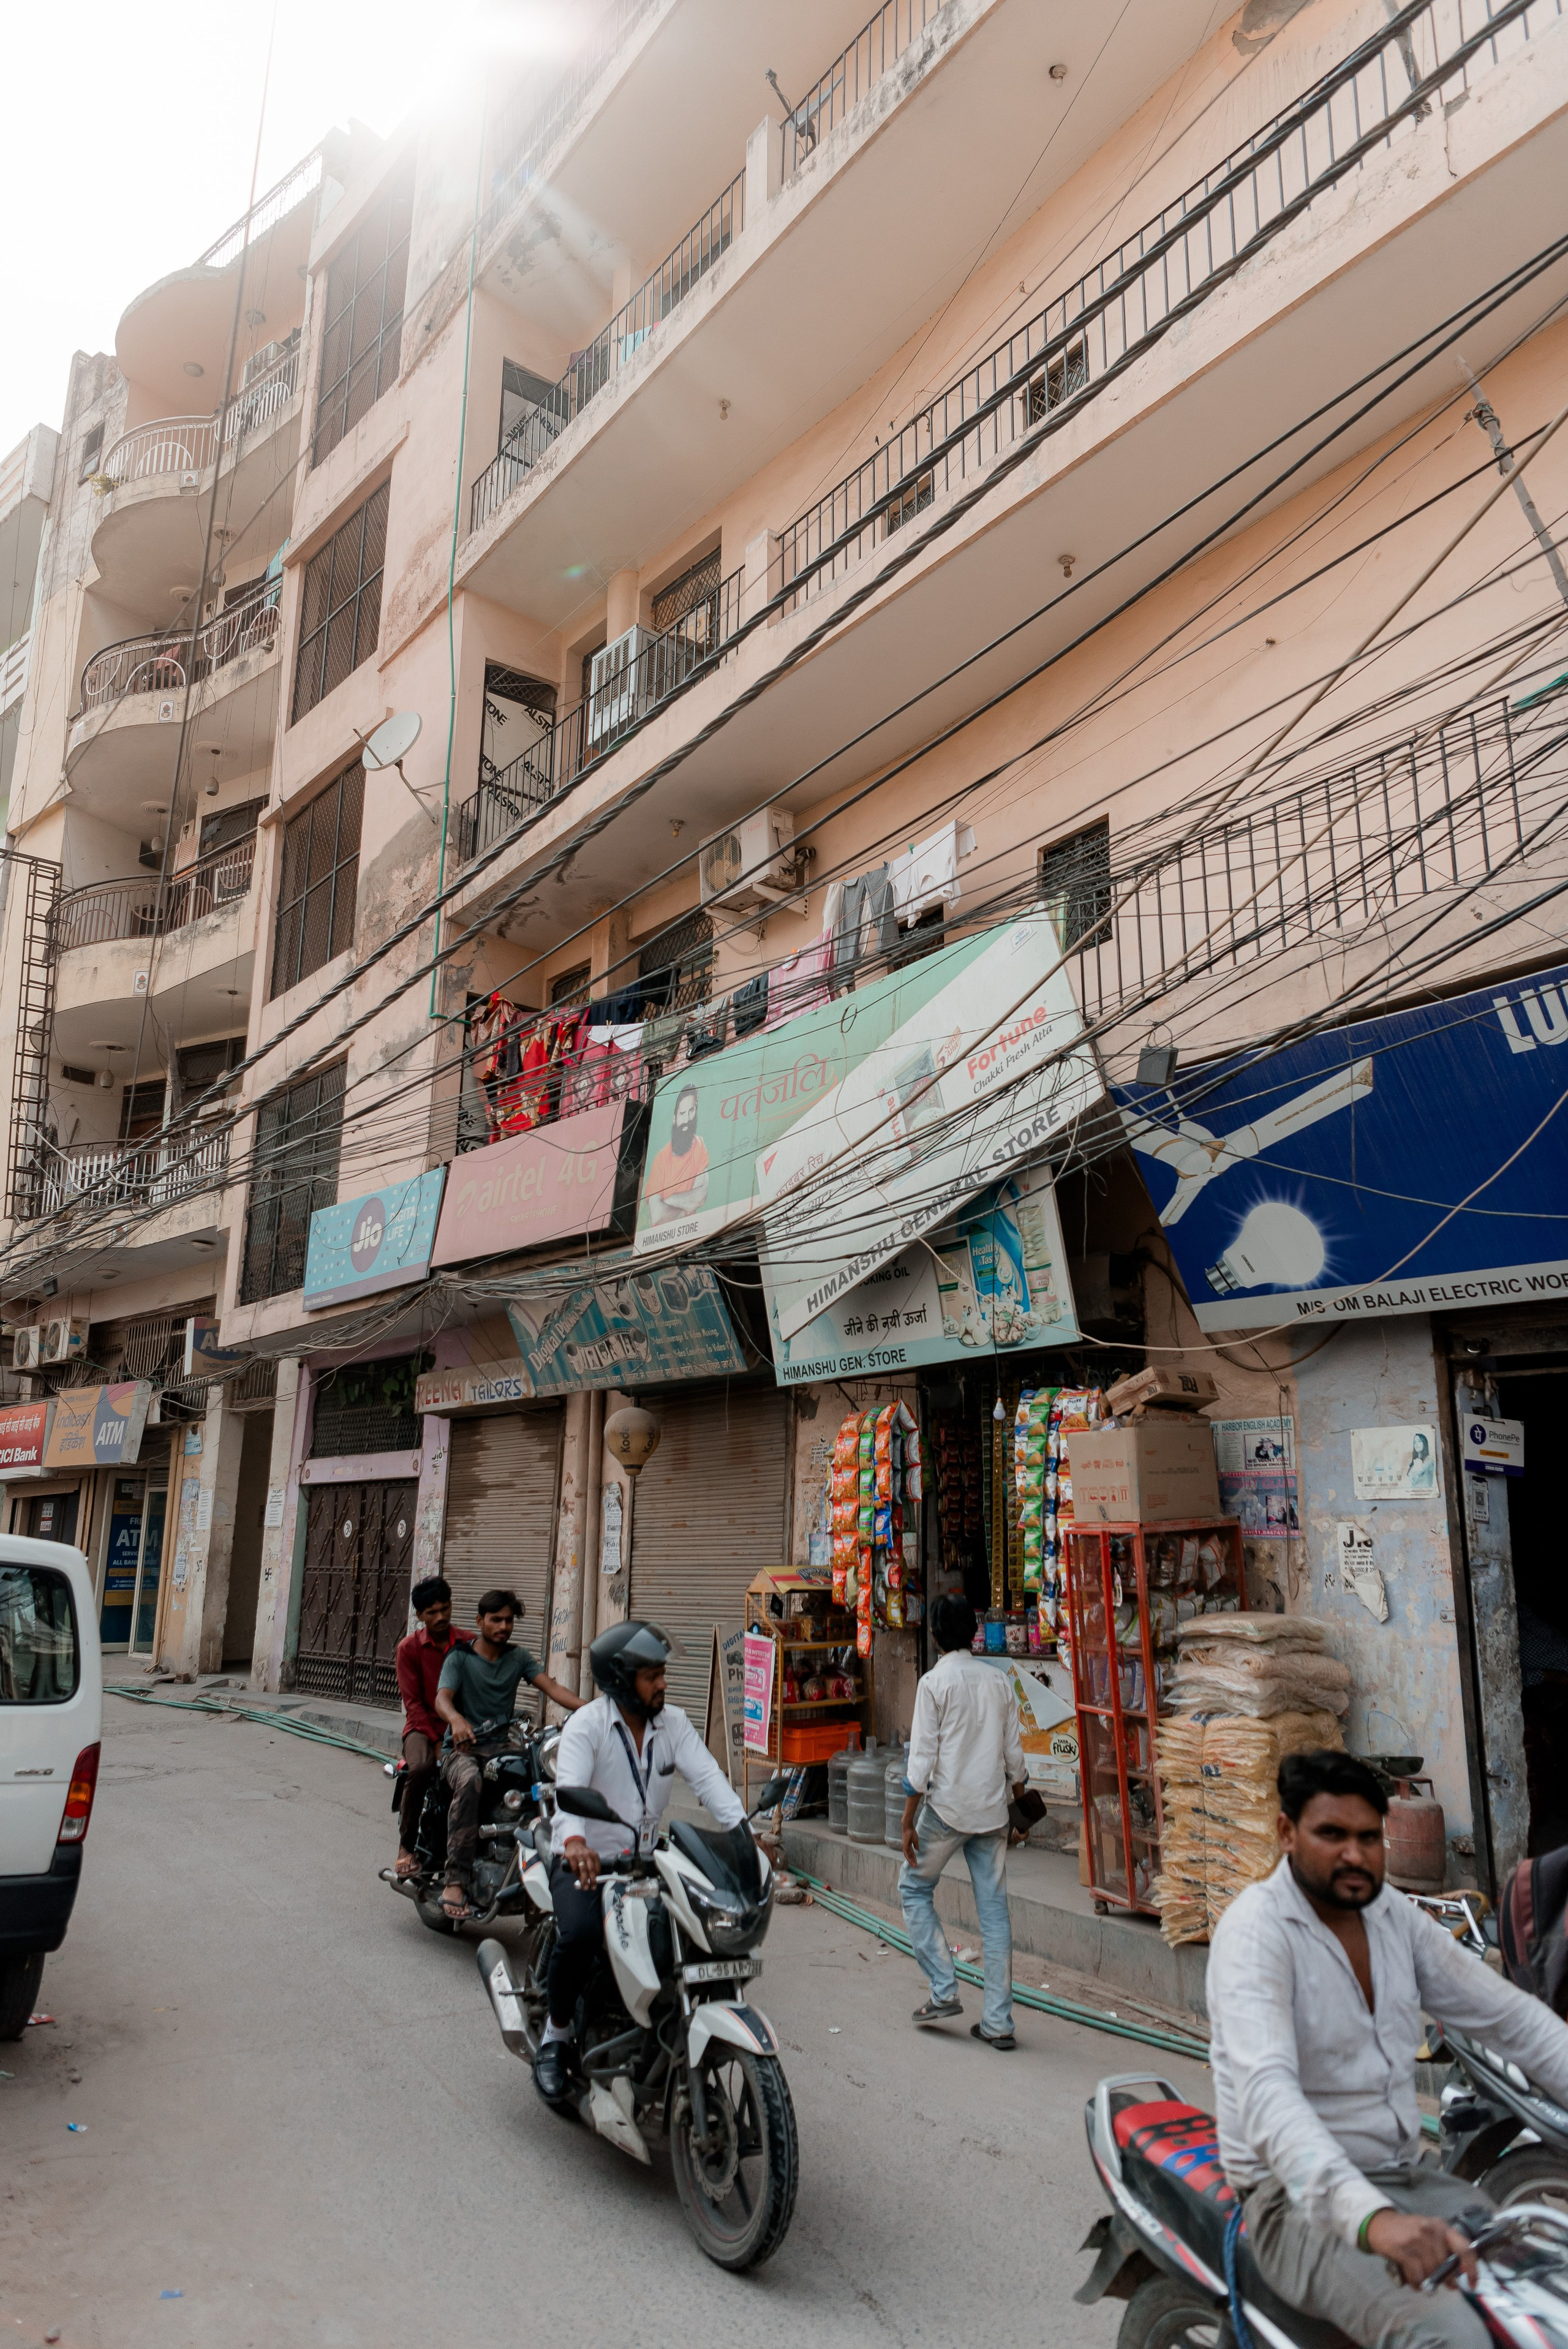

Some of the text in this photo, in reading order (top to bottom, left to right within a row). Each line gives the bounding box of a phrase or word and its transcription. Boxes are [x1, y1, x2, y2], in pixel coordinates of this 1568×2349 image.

[1493, 981, 1568, 1054] LU
[967, 1006, 1047, 1080] Fortune
[973, 1025, 1054, 1095] Chakki Fresh Atta
[720, 1053, 831, 1122] पतंजलि
[478, 1140, 600, 1213] airtel 4G
[390, 1206, 420, 1223] DIGITAL
[510, 1205, 558, 1224] SMARTPHONE
[807, 1231, 897, 1313] HIMANSHU
[992, 1107, 1061, 1165] STORE
[353, 1215, 383, 1252] Jio
[387, 1224, 405, 1242] LIFE
[643, 1221, 699, 1248] HIMANSHU STORE
[894, 1266, 910, 1278] OIL
[1332, 1295, 1362, 1313] OM
[1363, 1286, 1427, 1309] BALAJI
[1431, 1277, 1521, 1302] ELECTRIC
[843, 1303, 927, 1337] जीने की नयी ऊर्जा
[528, 1329, 562, 1372] Digital
[554, 1310, 580, 1341] Photo
[712, 1342, 726, 1351] Video
[783, 1348, 907, 1380] HIMANSHU GEN. STORE
[471, 1378, 522, 1401] TAILORS
[96, 1420, 125, 1446] ATM
[1221, 1417, 1292, 1432] HARBOR ENGLISH ACADEMY
[1489, 1430, 1520, 1442] PhonePe
[13, 1446, 39, 1463] Bank
[1262, 1477, 1295, 1488] CLUB
[130, 1517, 143, 1525] FRE
[722, 1629, 745, 1651] DIGITA
